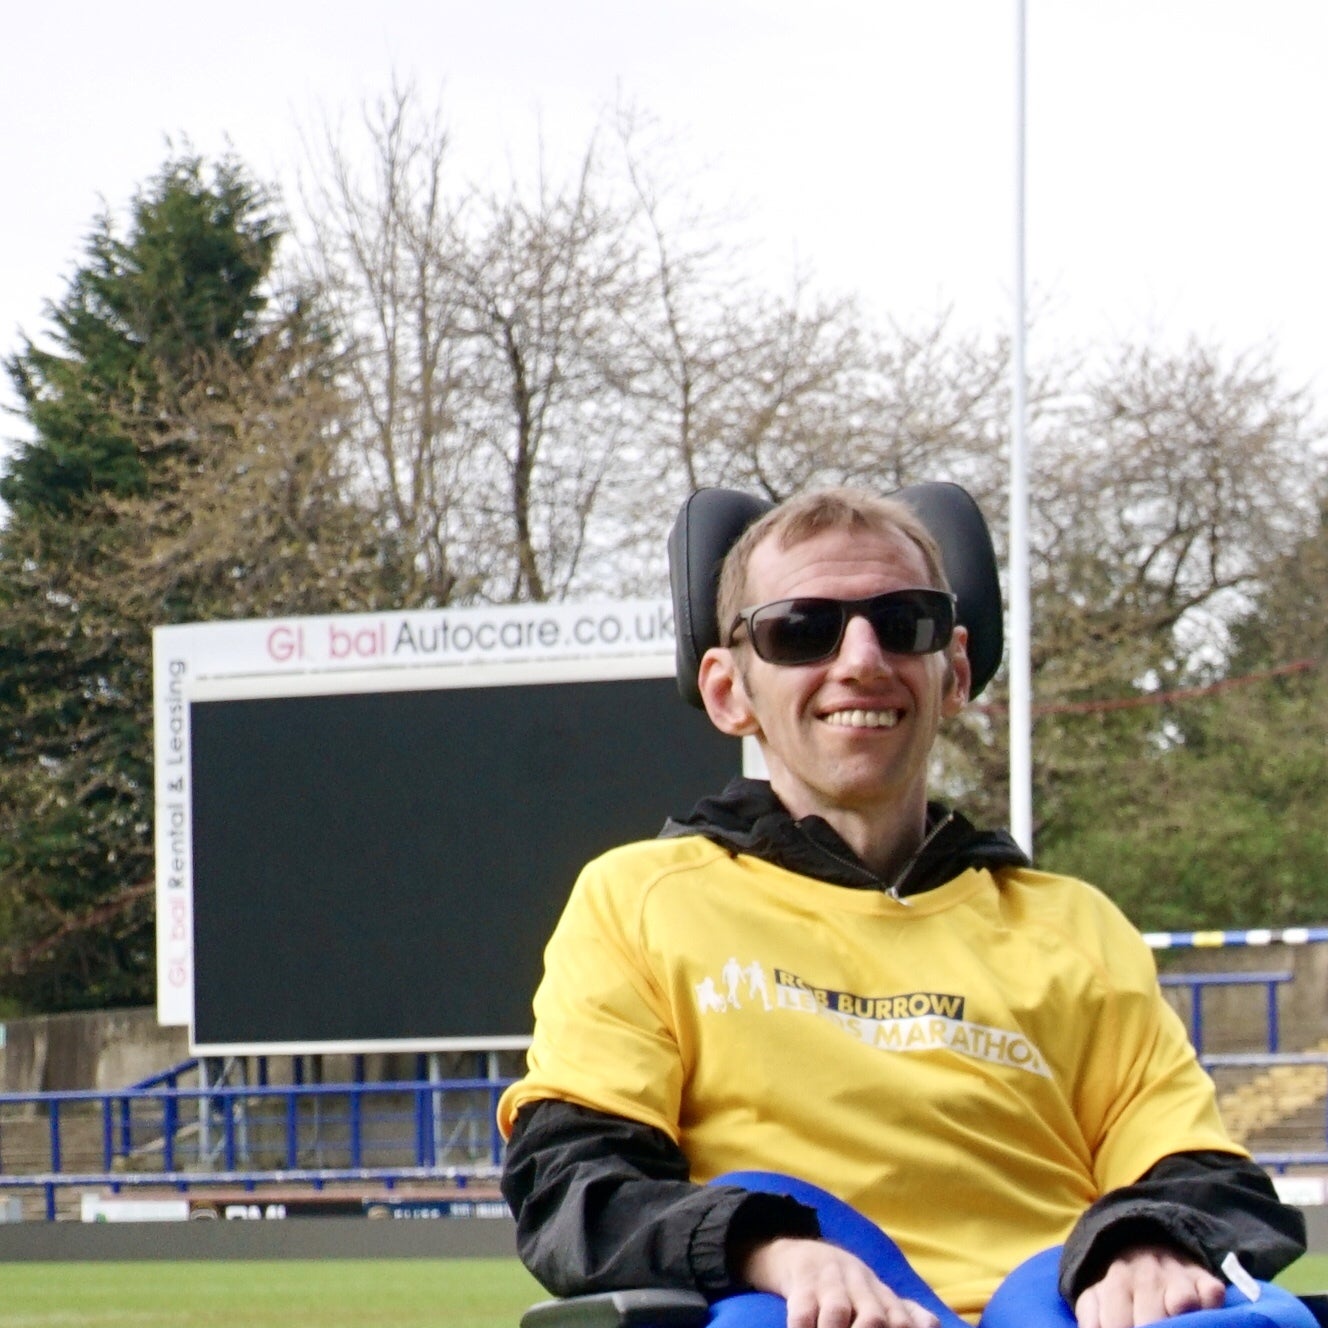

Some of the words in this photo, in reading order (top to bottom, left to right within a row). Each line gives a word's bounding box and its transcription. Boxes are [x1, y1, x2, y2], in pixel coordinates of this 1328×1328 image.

[166, 658, 187, 766] Leasing
[167, 801, 187, 888] Rental
[837, 992, 962, 1021] BURROW
